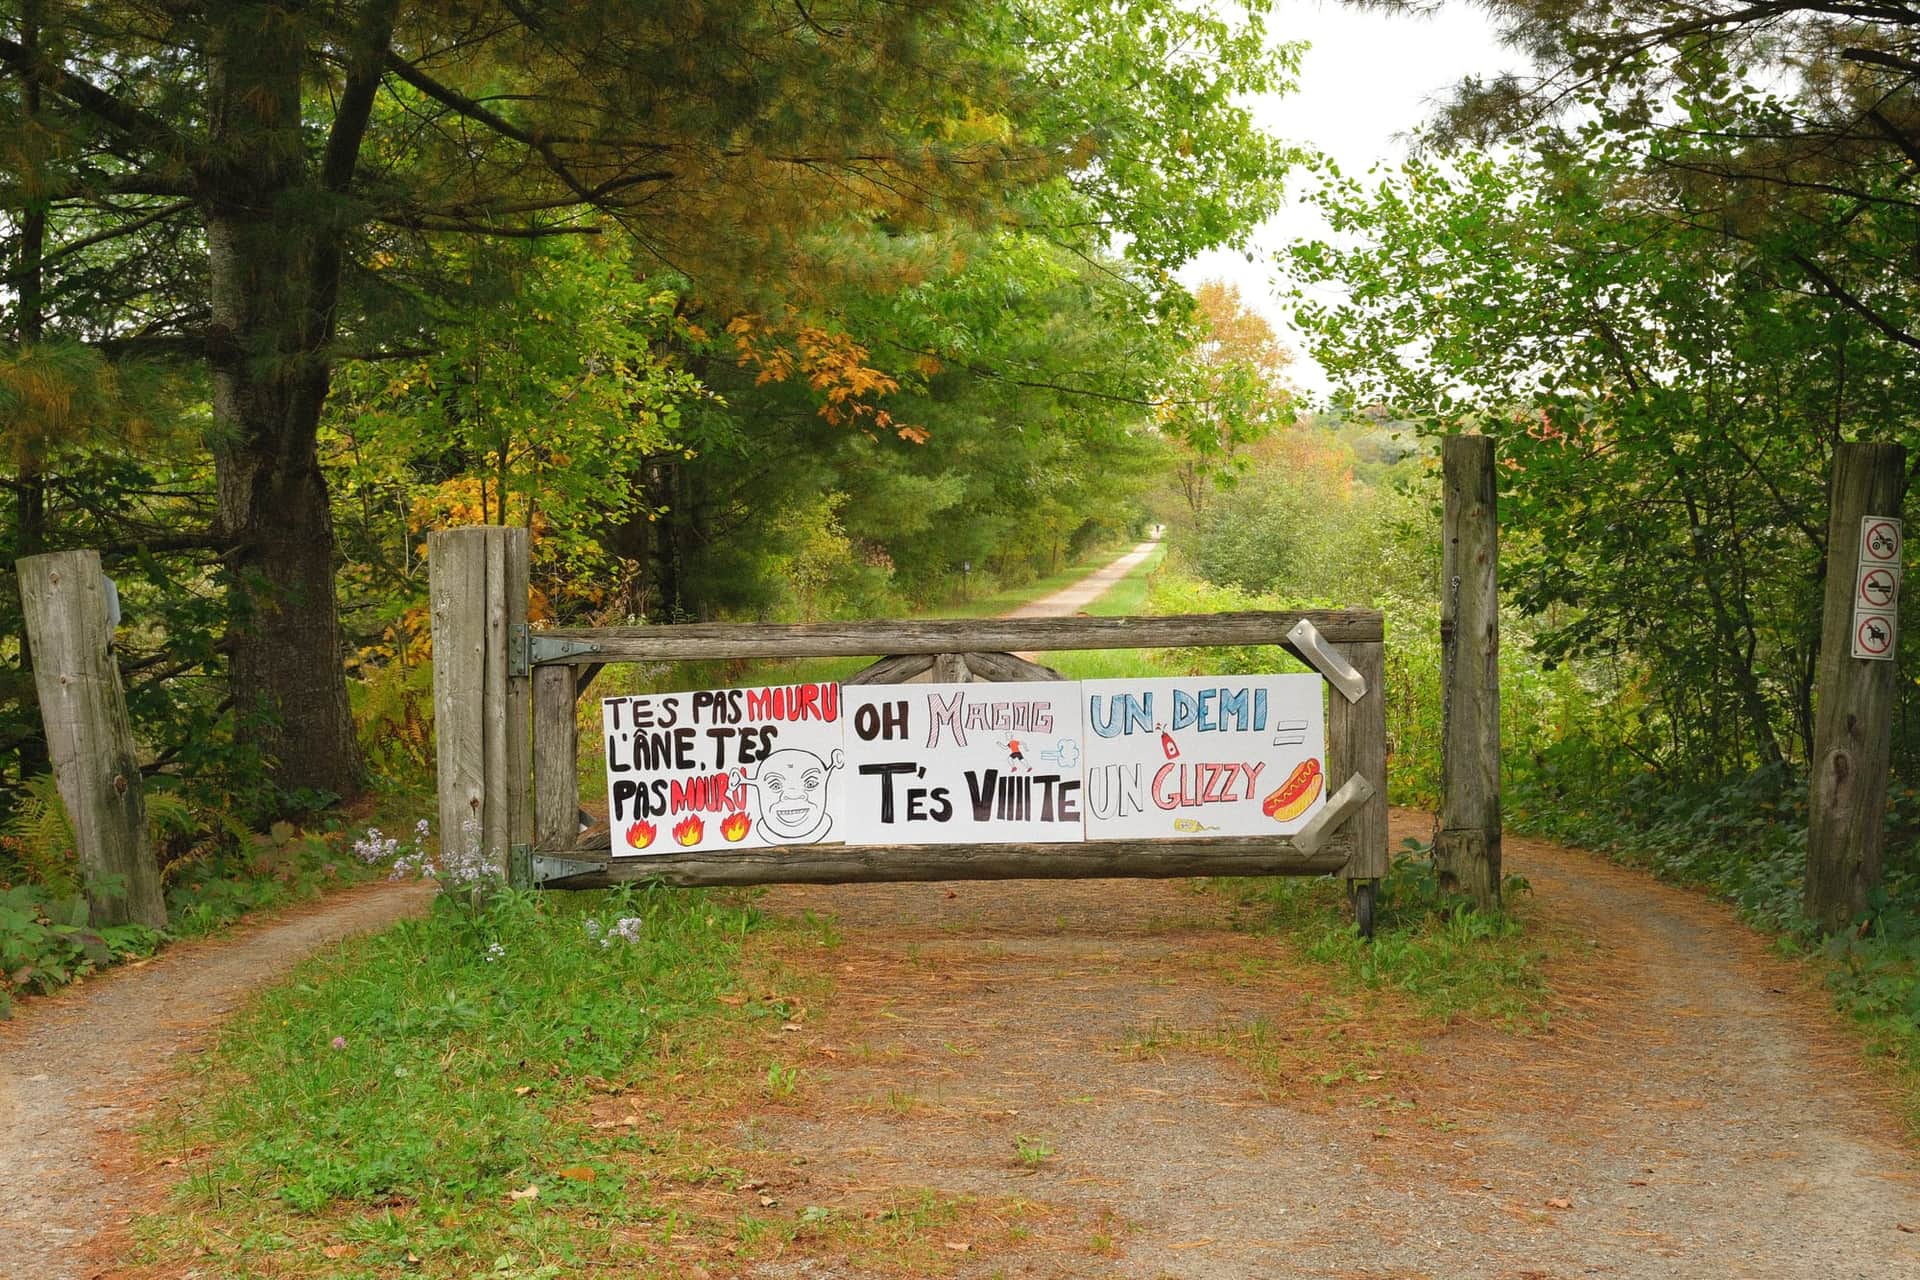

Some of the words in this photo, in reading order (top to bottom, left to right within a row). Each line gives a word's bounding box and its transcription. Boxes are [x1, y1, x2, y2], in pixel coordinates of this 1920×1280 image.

[604, 697, 679, 730] T'ES
[693, 690, 742, 725] PAS
[747, 681, 838, 722] MOURU
[854, 700, 909, 741] OH
[926, 691, 1054, 749] MAGOG
[1090, 692, 1153, 739] UN
[1172, 688, 1268, 732] DEMI
[706, 725, 778, 769] T'ES
[613, 779, 668, 821] PAS
[670, 767, 748, 816] MOURU
[858, 762, 953, 824] T'ES
[1088, 763, 1144, 820] UN
[1151, 761, 1266, 811] GLIZZY
